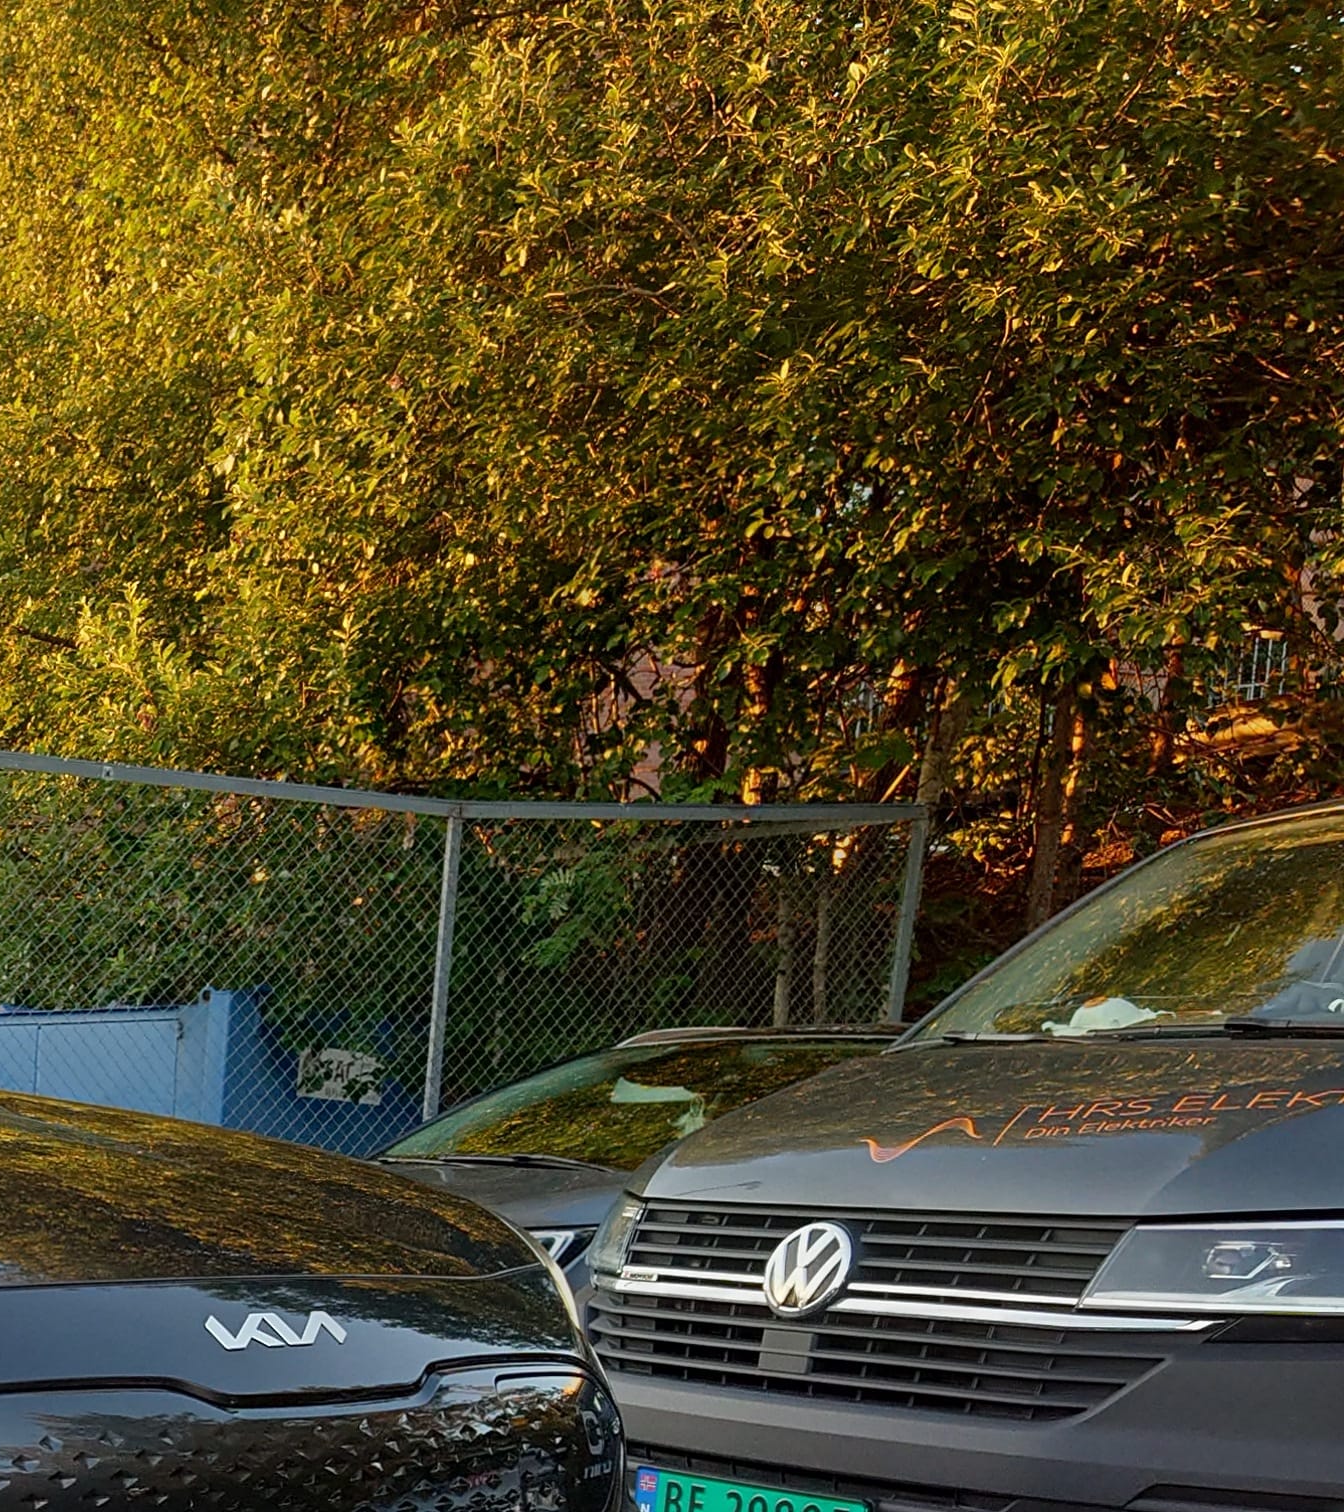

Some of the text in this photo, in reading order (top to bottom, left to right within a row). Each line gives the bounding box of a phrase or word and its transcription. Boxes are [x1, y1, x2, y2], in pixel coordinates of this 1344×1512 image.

[1024, 1116, 1216, 1140] Din Elektriker
[204, 1311, 348, 1351] KIA
